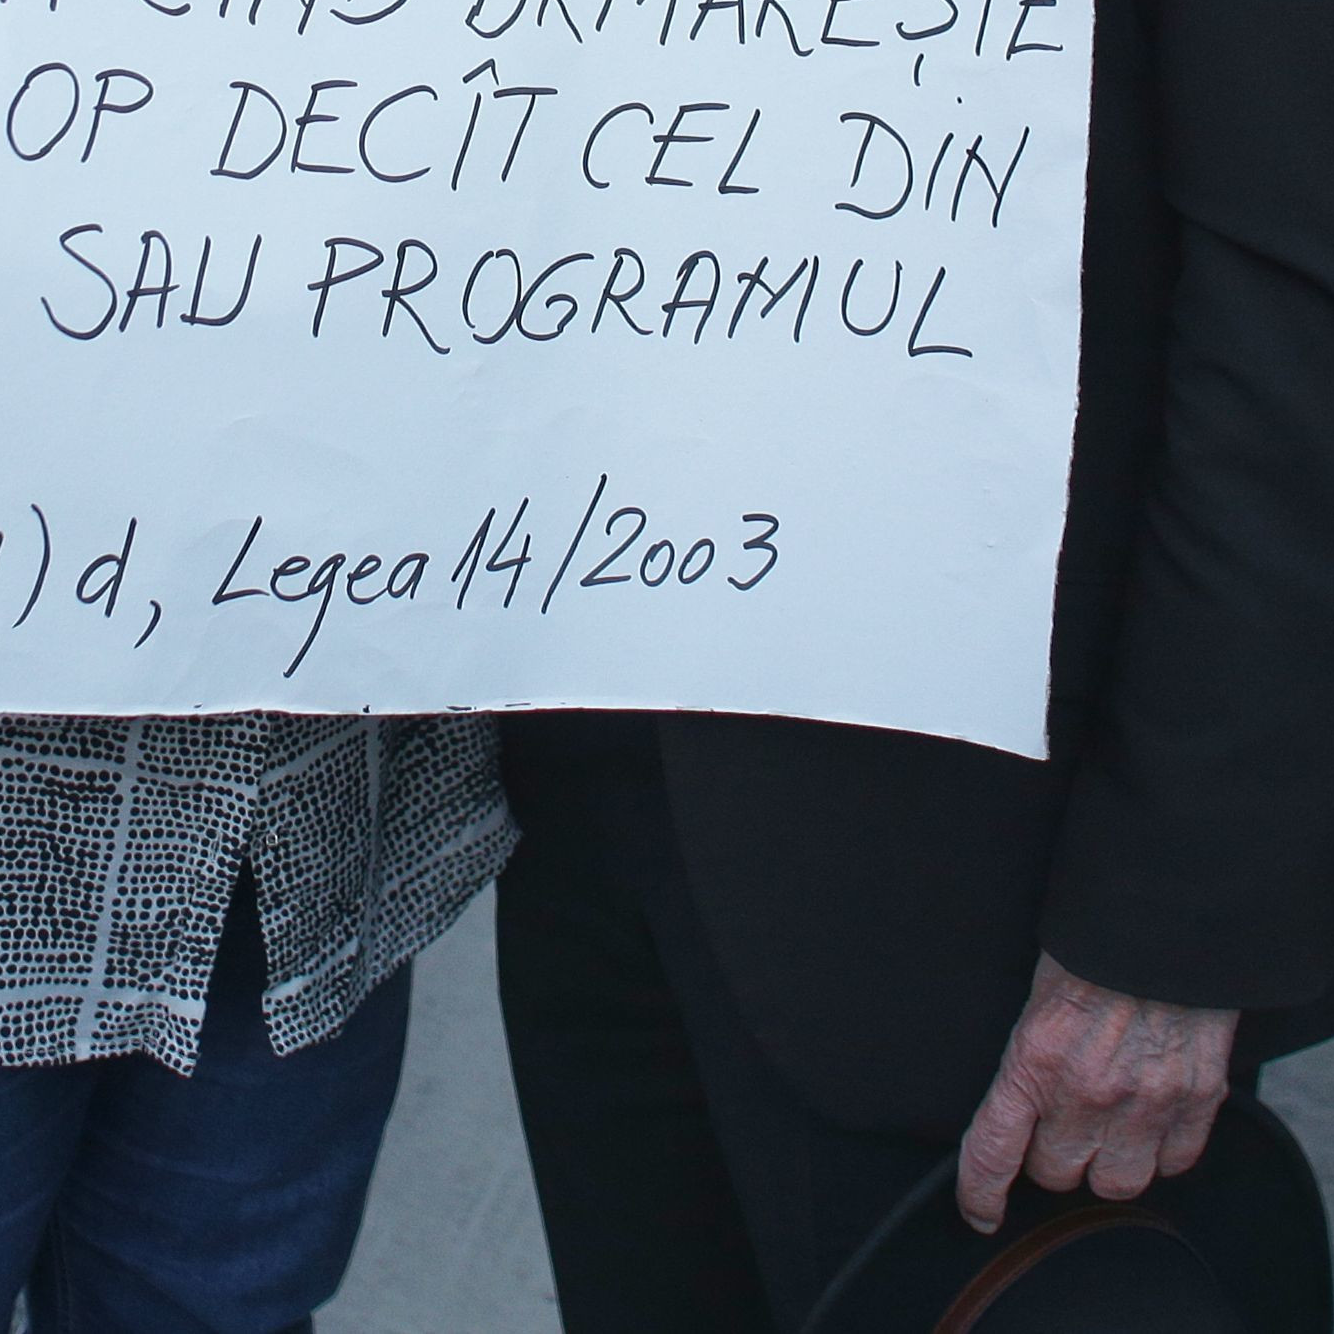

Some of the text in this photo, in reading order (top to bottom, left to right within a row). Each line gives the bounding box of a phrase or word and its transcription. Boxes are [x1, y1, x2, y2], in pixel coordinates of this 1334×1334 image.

[209, 57, 559, 192] DECÎT
[582, 102, 761, 195] CEL
[40, 223, 263, 341] SAU
[306, 236, 974, 359] PROGRAMUL
[75, 516, 162, 649] d,
[211, 515, 430, 679] Legea
[450, 472, 780, 615] 14/2003
